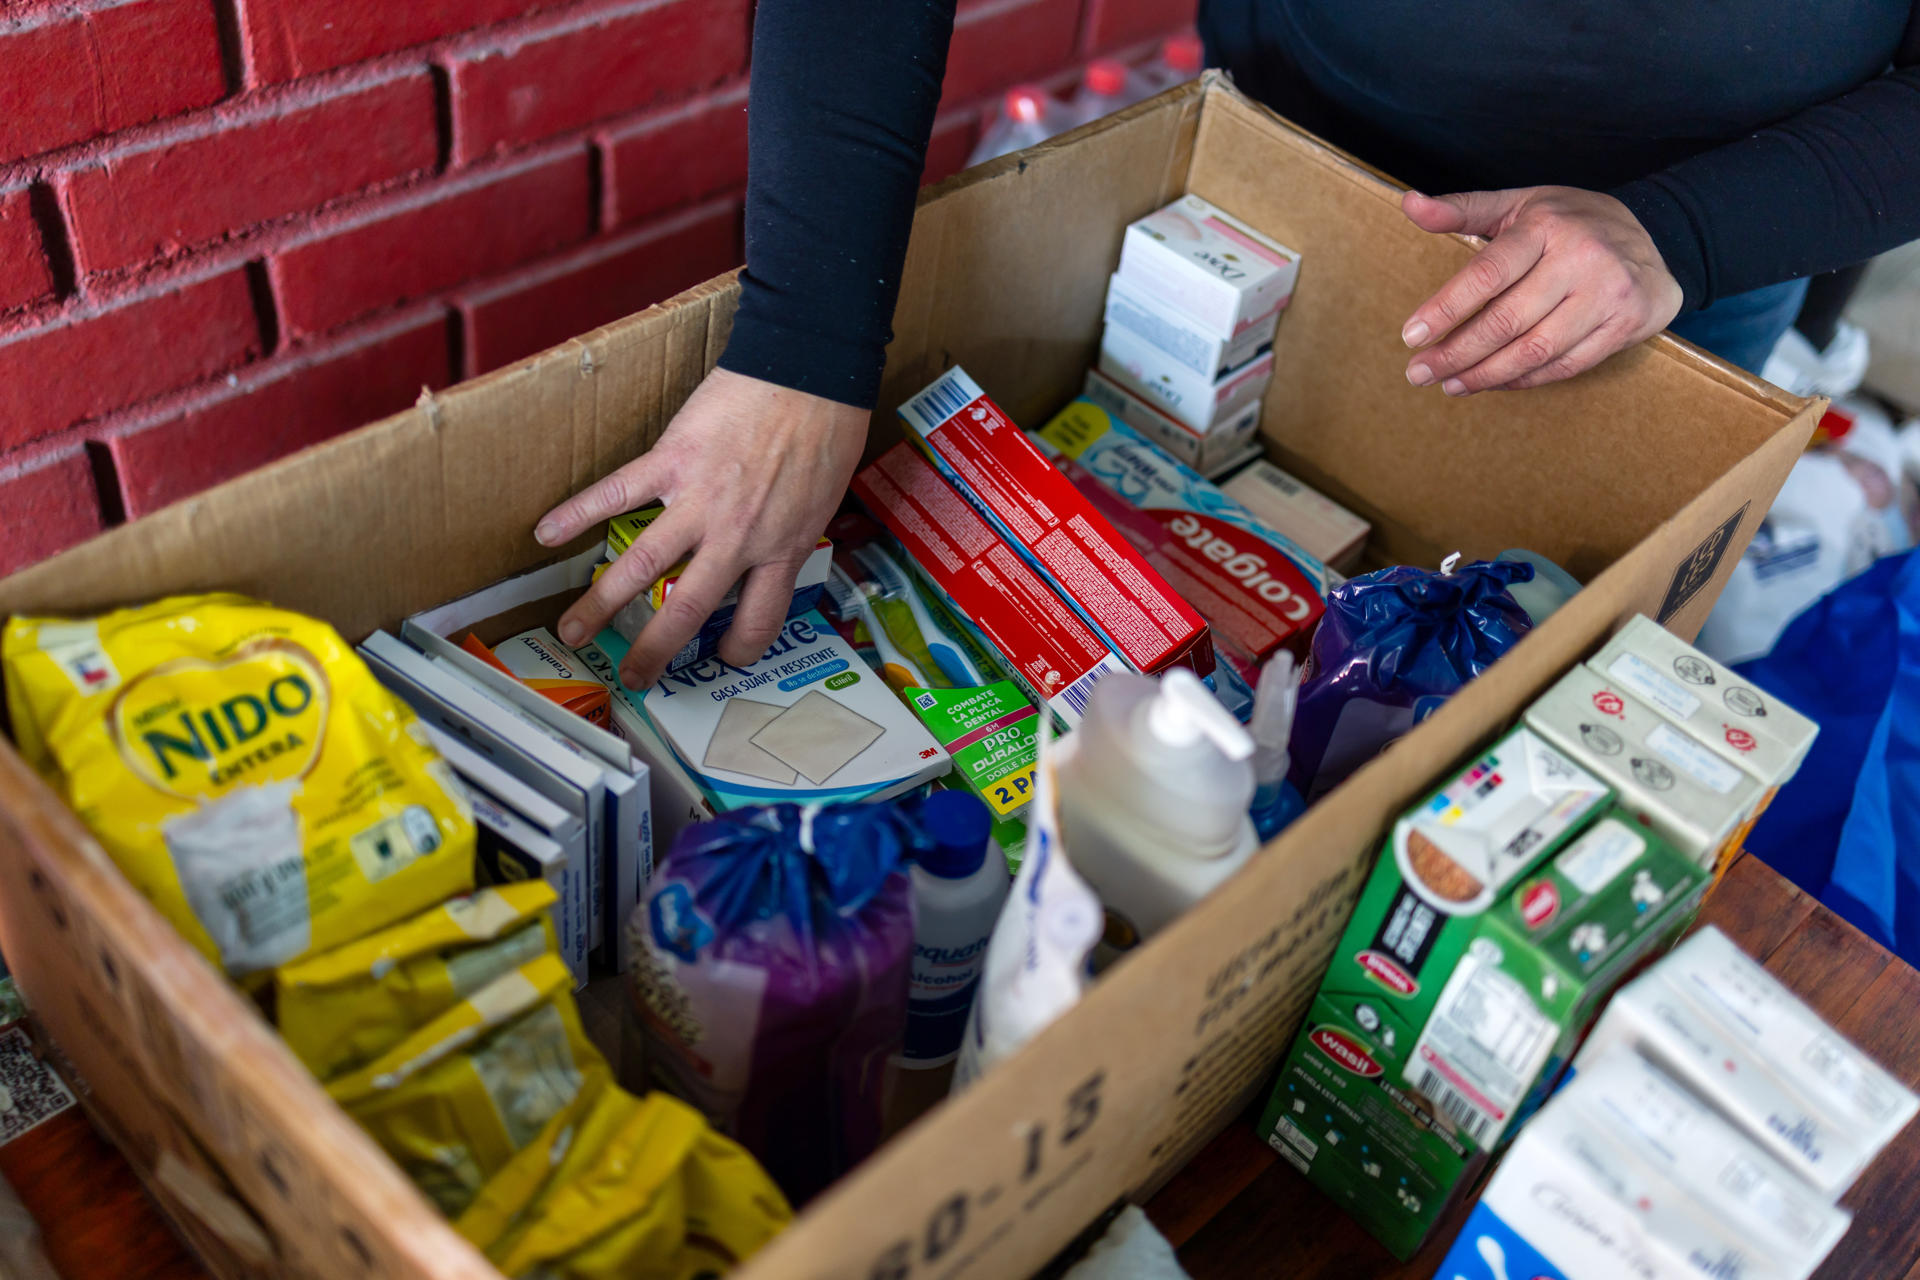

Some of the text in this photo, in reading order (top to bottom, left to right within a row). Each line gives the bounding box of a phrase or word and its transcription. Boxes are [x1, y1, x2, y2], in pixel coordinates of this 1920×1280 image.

[1170, 513, 1311, 623] Colgate
[520, 636, 572, 679] Cranberry
[656, 617, 818, 698] Nexare
[711, 646, 839, 703] GASA SUAVE Y RESISTENTE
[786, 678, 798, 688] No
[830, 672, 855, 688] Estéril
[946, 689, 996, 715] COMBATE
[952, 697, 1003, 724] LA PLACA
[142, 674, 313, 779] NIDO
[963, 706, 1005, 729] DENTAL
[985, 722, 1000, 733] 6M
[982, 726, 1021, 752] PRO
[918, 747, 938, 759] 3M
[986, 761, 1020, 782] DOBLE
[995, 787, 1015, 805] 2
[911, 938, 989, 964] equat
[910, 968, 974, 985] Alcohol
[1322, 1032, 1370, 1074] wasil
